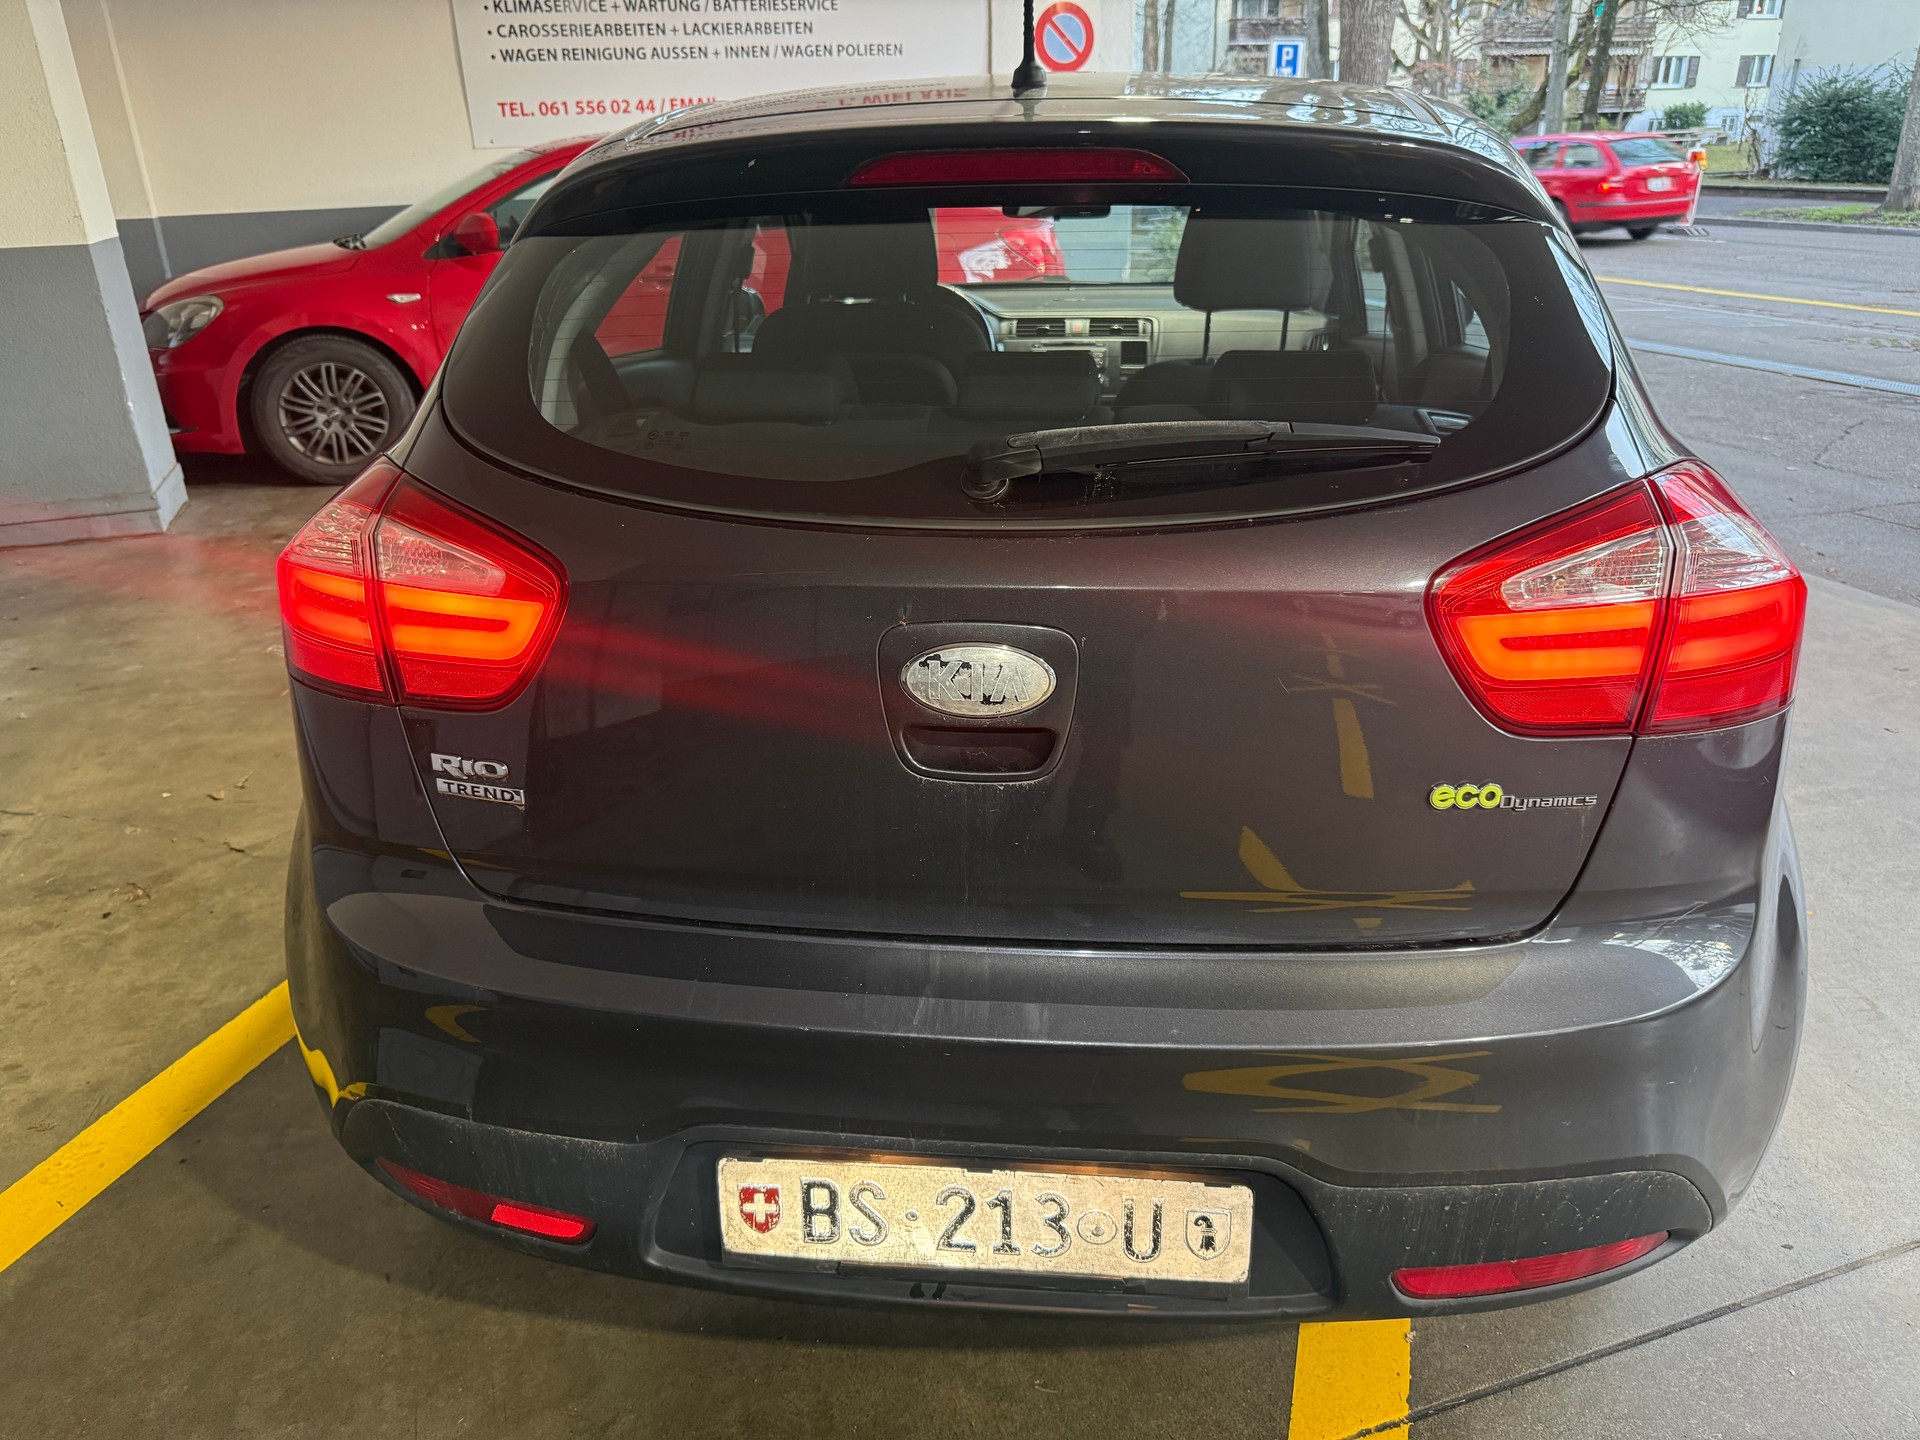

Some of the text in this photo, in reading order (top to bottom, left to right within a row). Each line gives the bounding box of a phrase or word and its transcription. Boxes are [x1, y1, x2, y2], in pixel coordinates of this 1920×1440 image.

[493, 0, 607, 13] KLIMASERVICE
[625, 0, 700, 12] WARTUNG
[713, 0, 838, 11] BATTERIESERVICE
[497, 23, 666, 38] CAROSSERIEARBEITEN
[683, 21, 813, 36] LACKIERARBEITEN
[500, 48, 557, 62] WAGEN
[562, 46, 647, 61] REINIGUNG
[651, 45, 708, 60] AUSSEN
[725, 44, 770, 59] INNEN
[781, 44, 833, 58] WAGEN
[837, 43, 903, 57] POLIEREN
[1281, 46, 1295, 68] P
[498, 101, 535, 118] TEL.
[539, 101, 569, 116] 061
[575, 100, 607, 115] 556
[610, 99, 631, 114] 02
[635, 98, 656, 113] 44
[926, 659, 1030, 702] KIA
[443, 781, 515, 802] TREND
